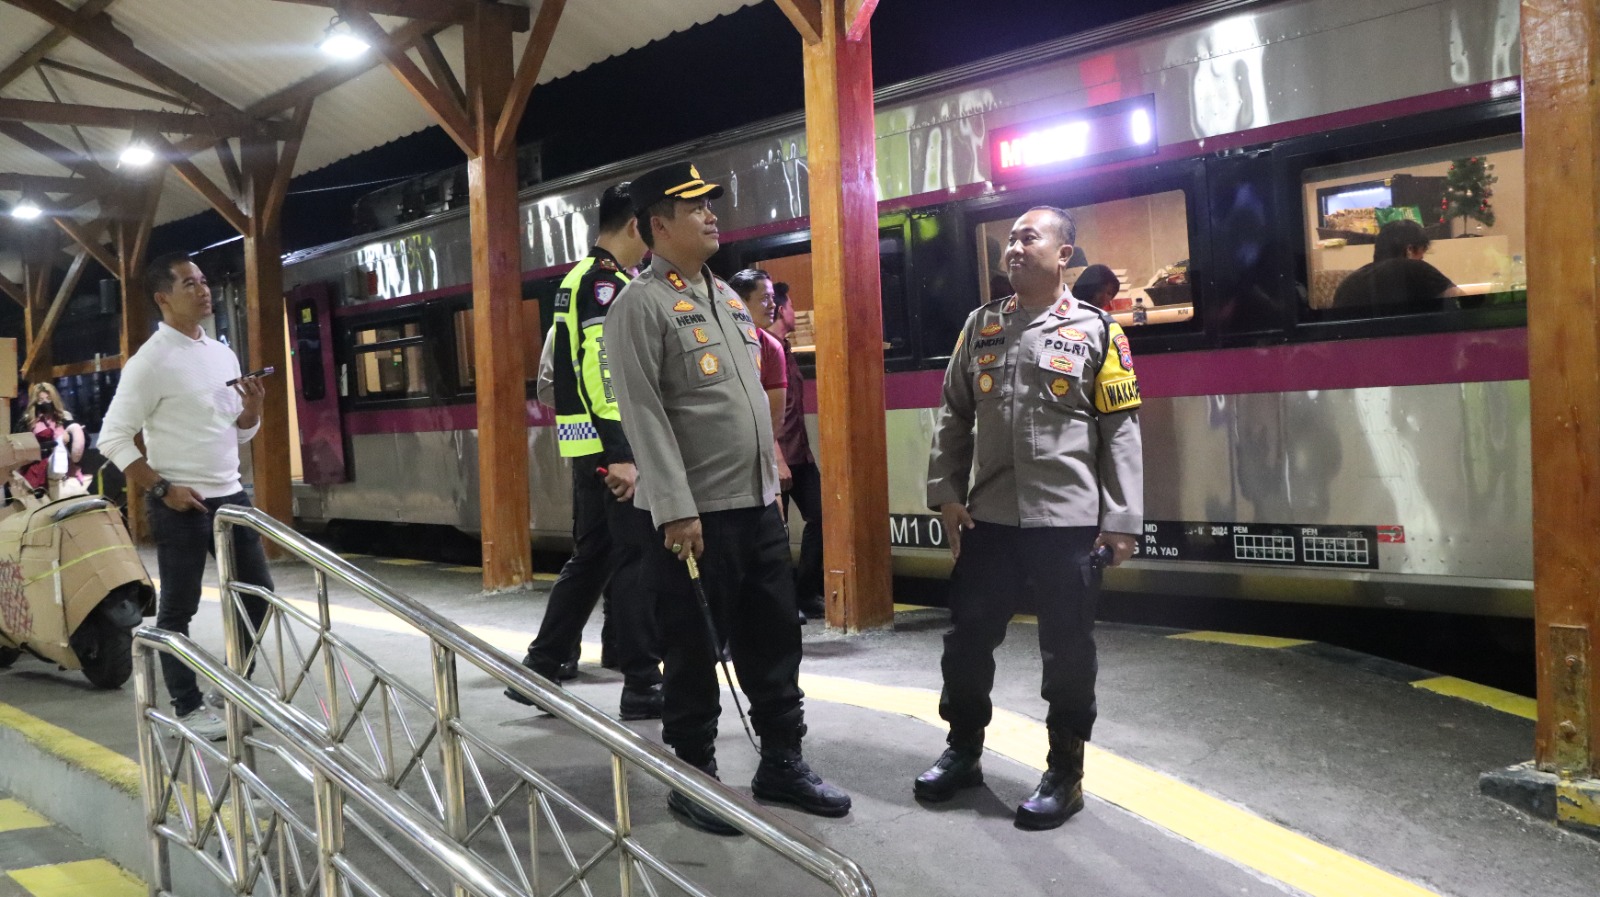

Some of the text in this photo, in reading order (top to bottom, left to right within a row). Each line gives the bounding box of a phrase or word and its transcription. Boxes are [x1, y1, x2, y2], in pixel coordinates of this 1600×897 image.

[675, 313, 707, 327] HENRI
[1044, 338, 1086, 357] POLRI
[1144, 523, 1158, 533] MD
[1233, 525, 1249, 534] PEM
[1145, 534, 1157, 544] PA
[1146, 546, 1159, 556] PA
[1159, 546, 1179, 557] YAD
